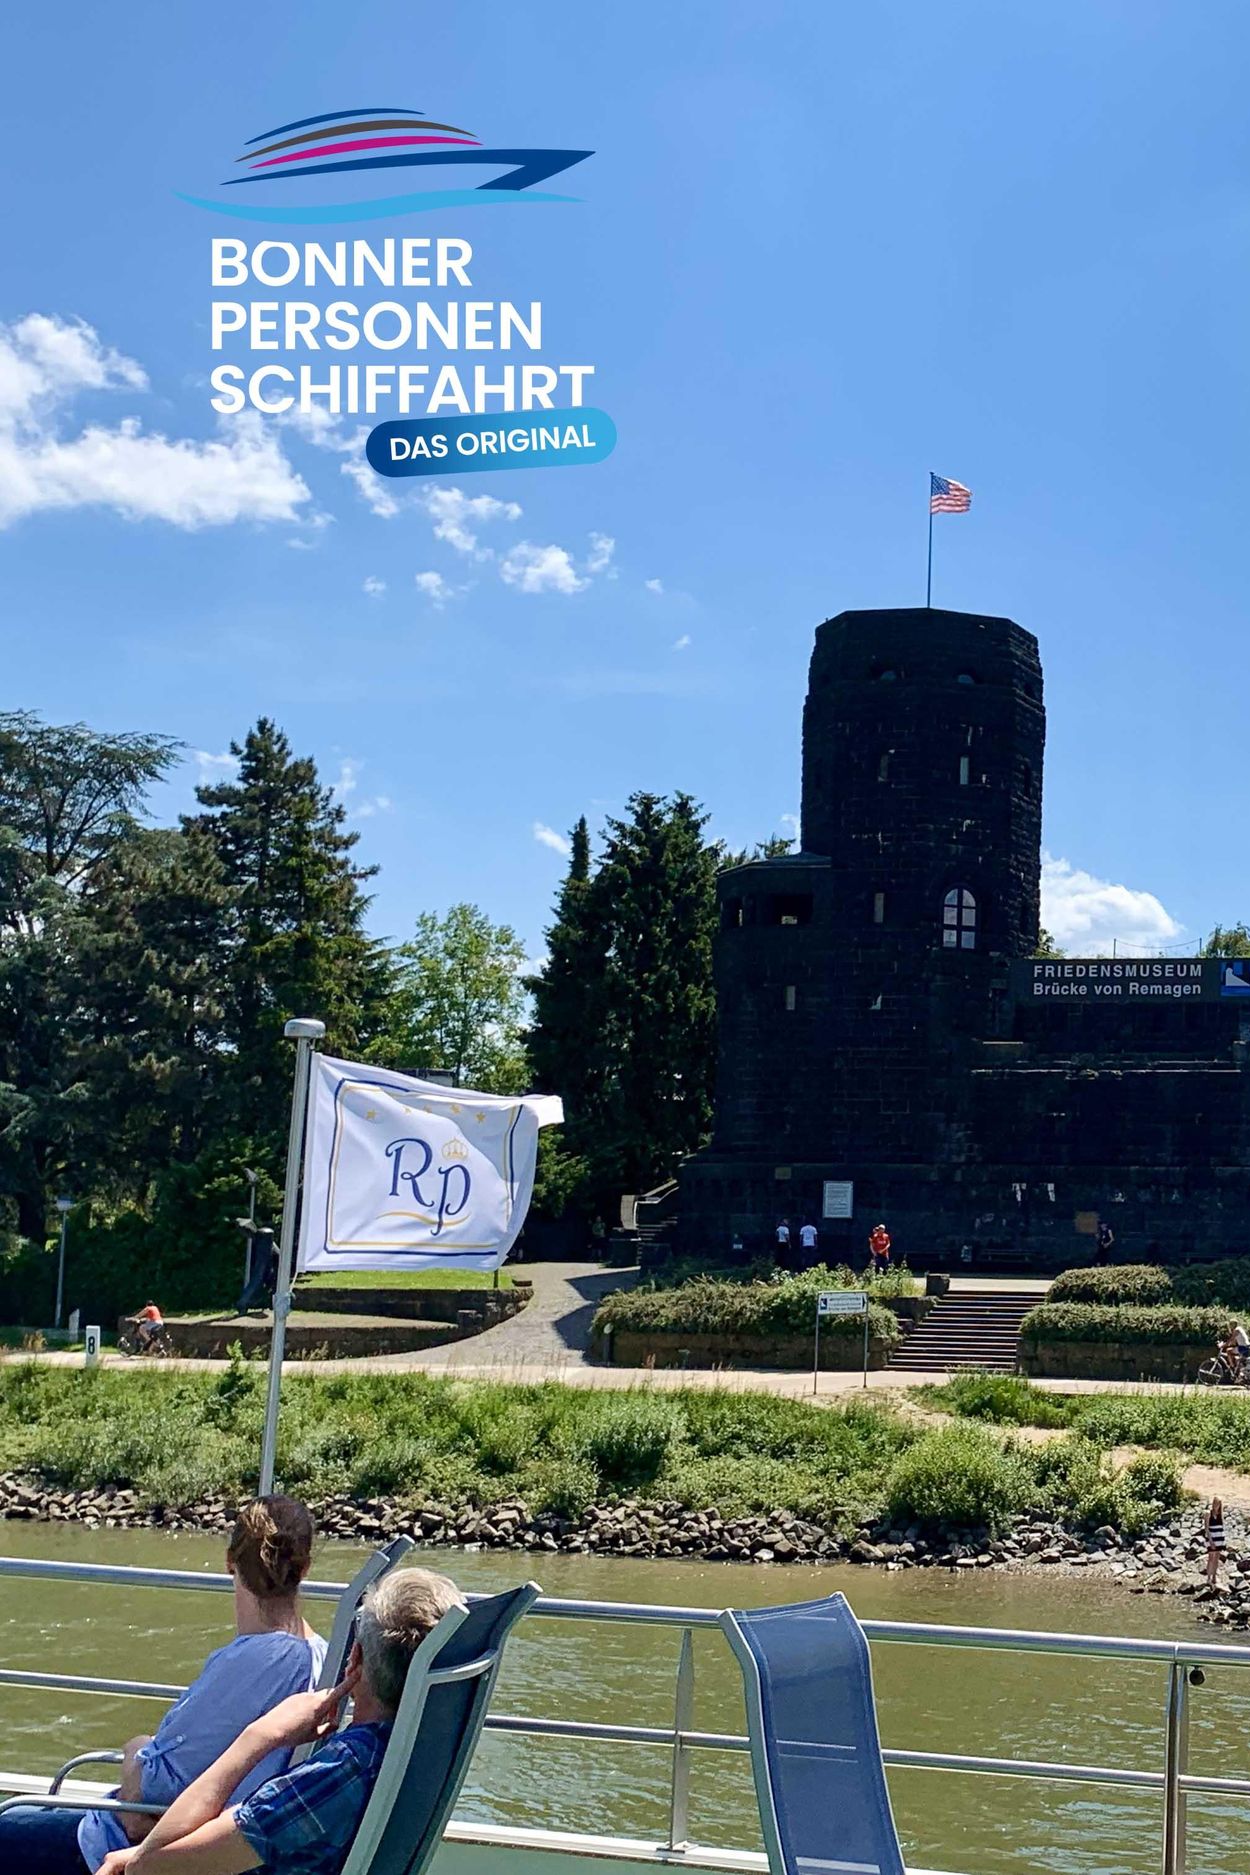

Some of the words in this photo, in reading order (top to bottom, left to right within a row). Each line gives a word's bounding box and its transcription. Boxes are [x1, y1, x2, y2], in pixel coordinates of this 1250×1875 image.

[1033, 964, 1202, 978] FRIEDENSMUSEUM
[1033, 983, 1088, 996] Brücke
[1094, 985, 1122, 996] von
[1129, 982, 1201, 998] Remagen
[88, 1336, 95, 1355] 8
